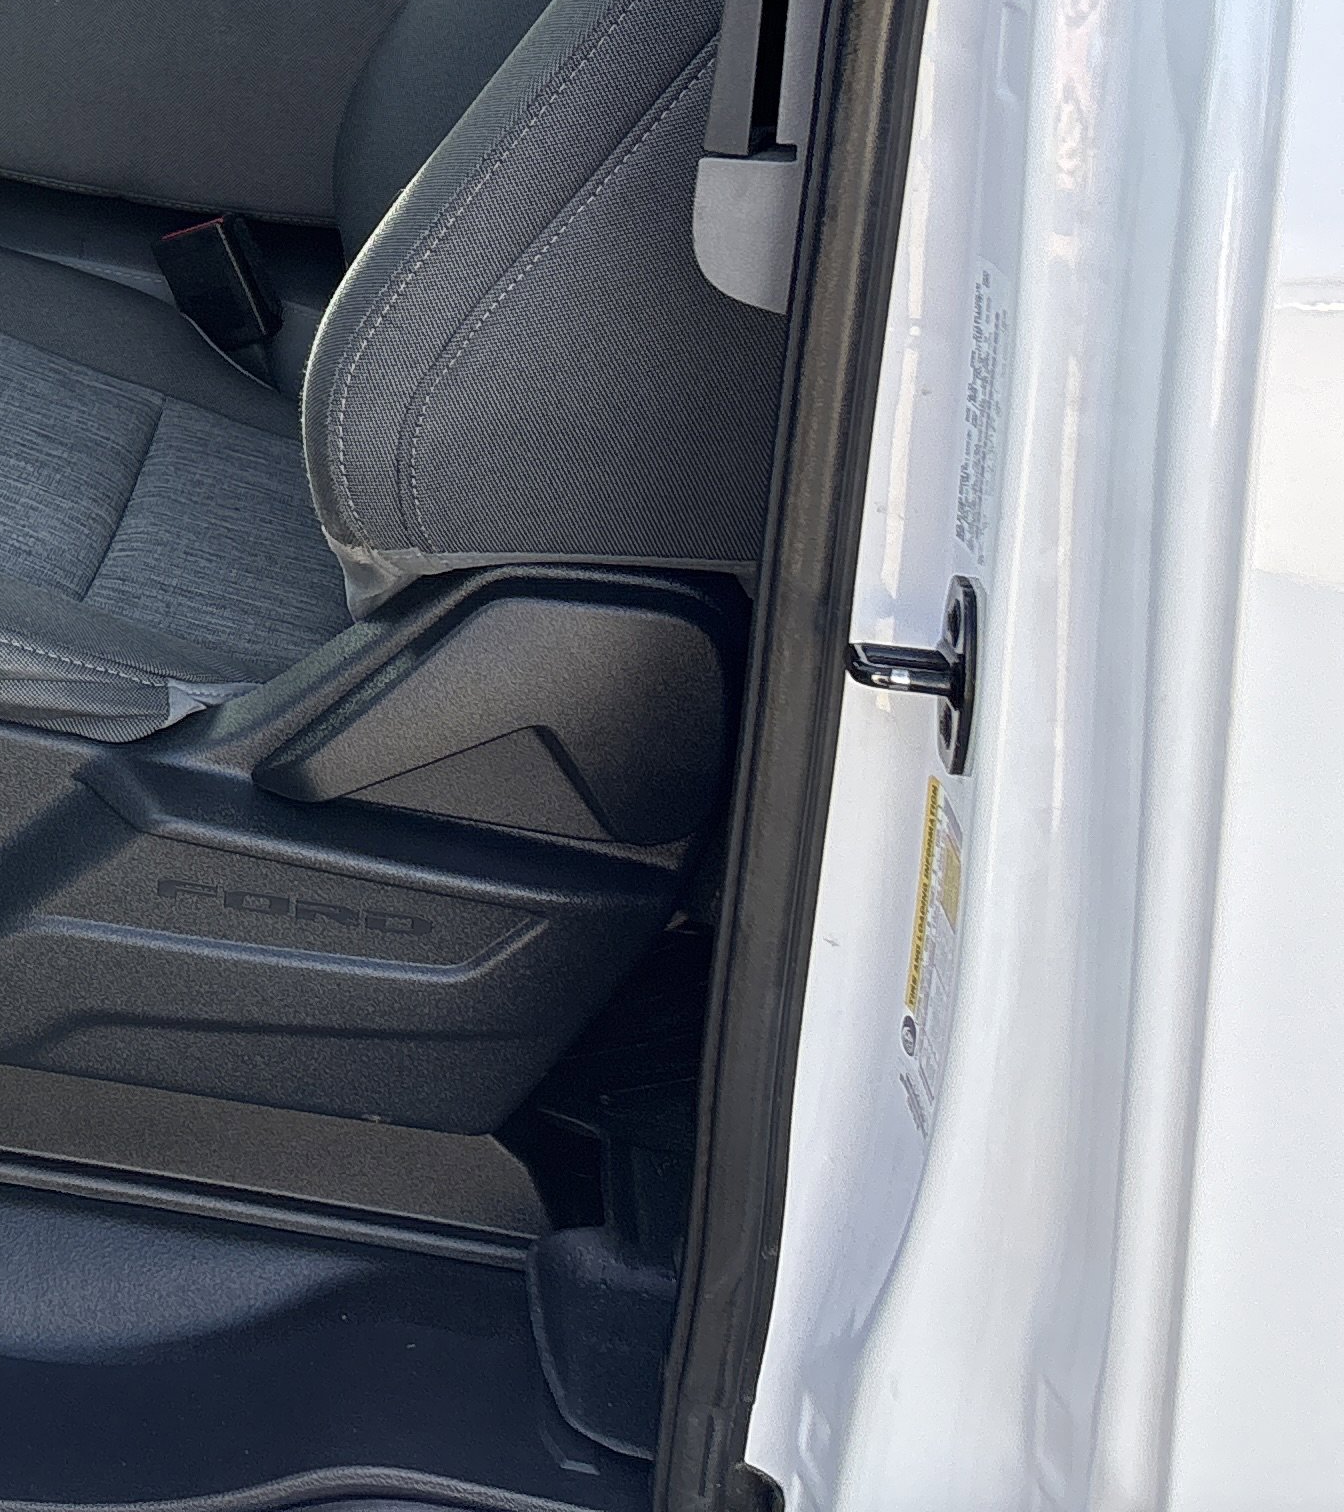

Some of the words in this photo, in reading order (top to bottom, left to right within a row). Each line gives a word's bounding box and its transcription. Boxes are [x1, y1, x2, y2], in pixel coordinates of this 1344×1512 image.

[157, 879, 433, 935] FORD
[917, 881, 929, 942] LOADING
[923, 784, 938, 879] INFORMATION
